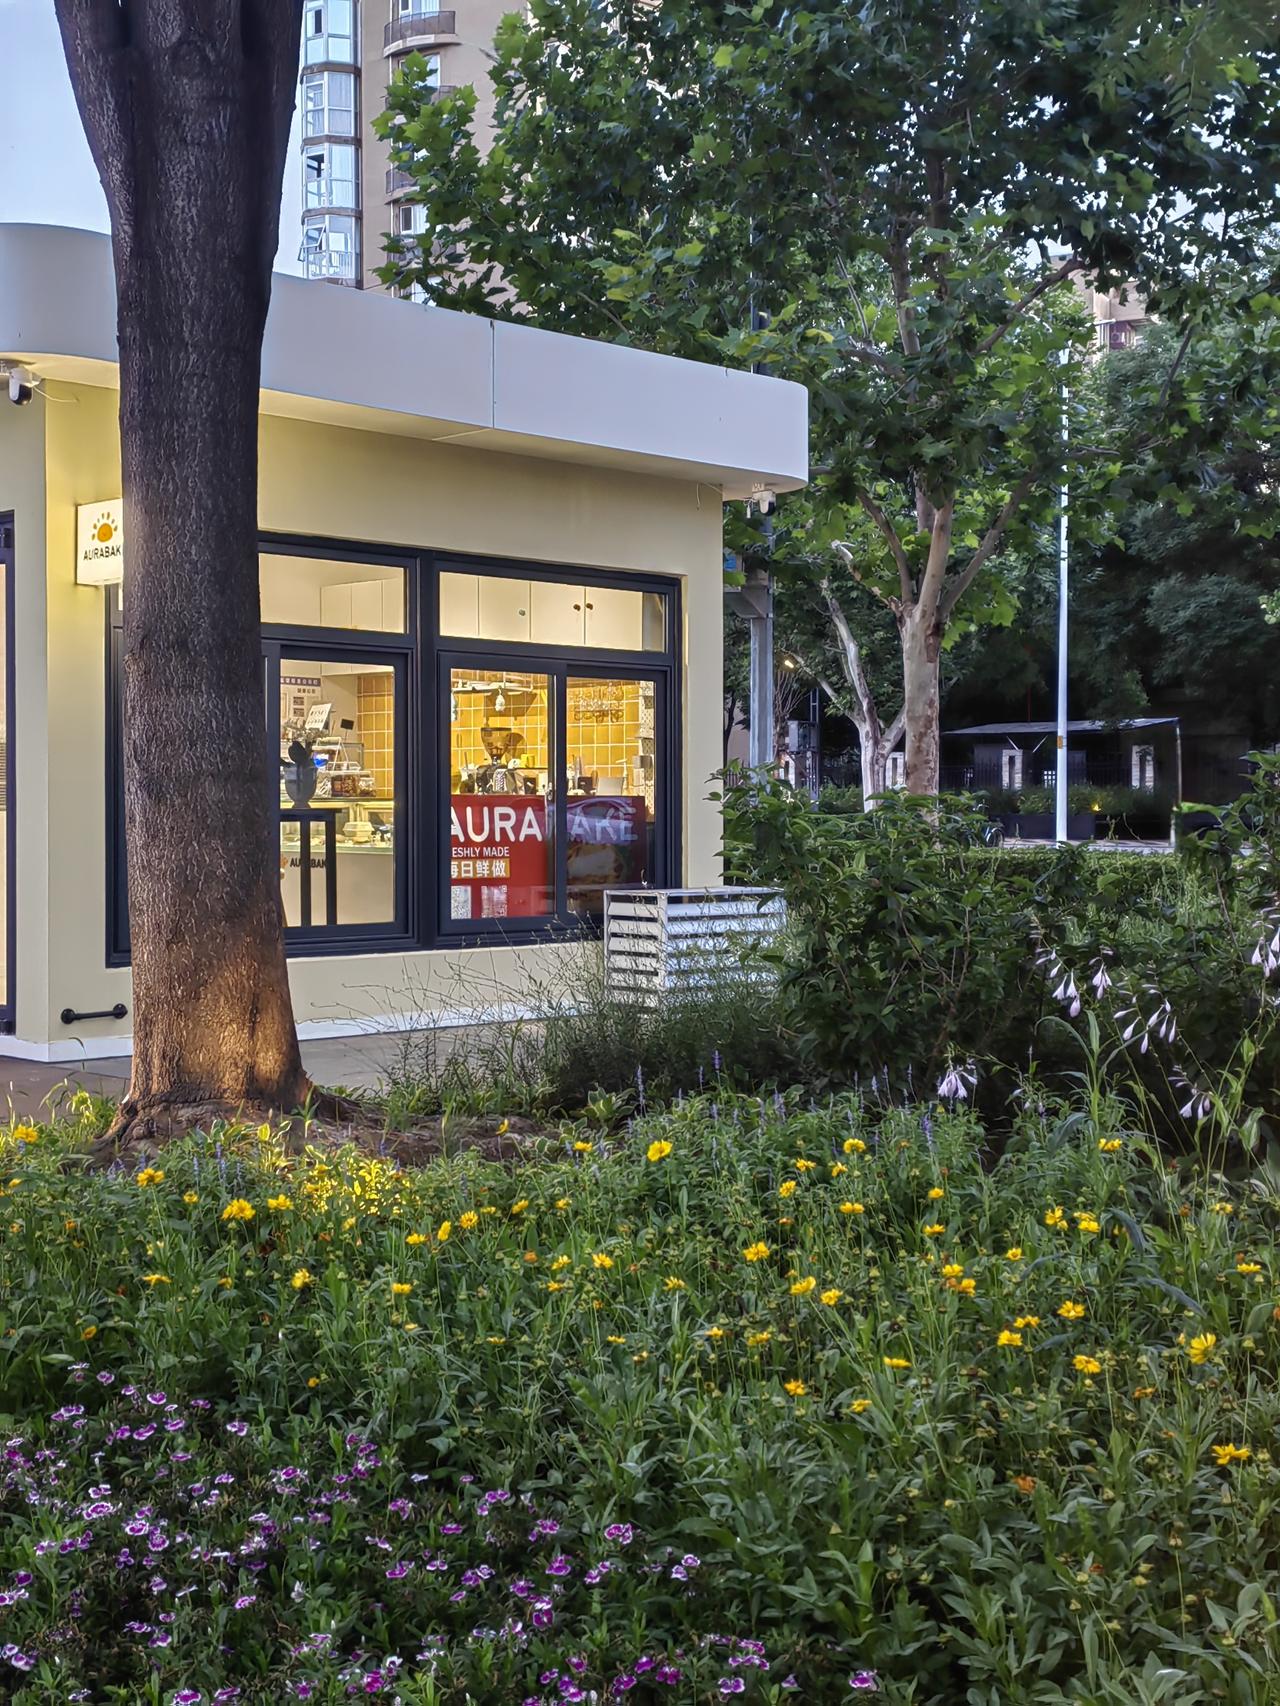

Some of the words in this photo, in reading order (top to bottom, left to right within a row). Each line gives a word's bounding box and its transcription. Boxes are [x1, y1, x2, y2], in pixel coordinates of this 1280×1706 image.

[84, 545, 121, 560] AURABAK
[450, 806, 638, 842] AURAAKE
[452, 847, 480, 857] ESHLY
[483, 847, 510, 857] MADE
